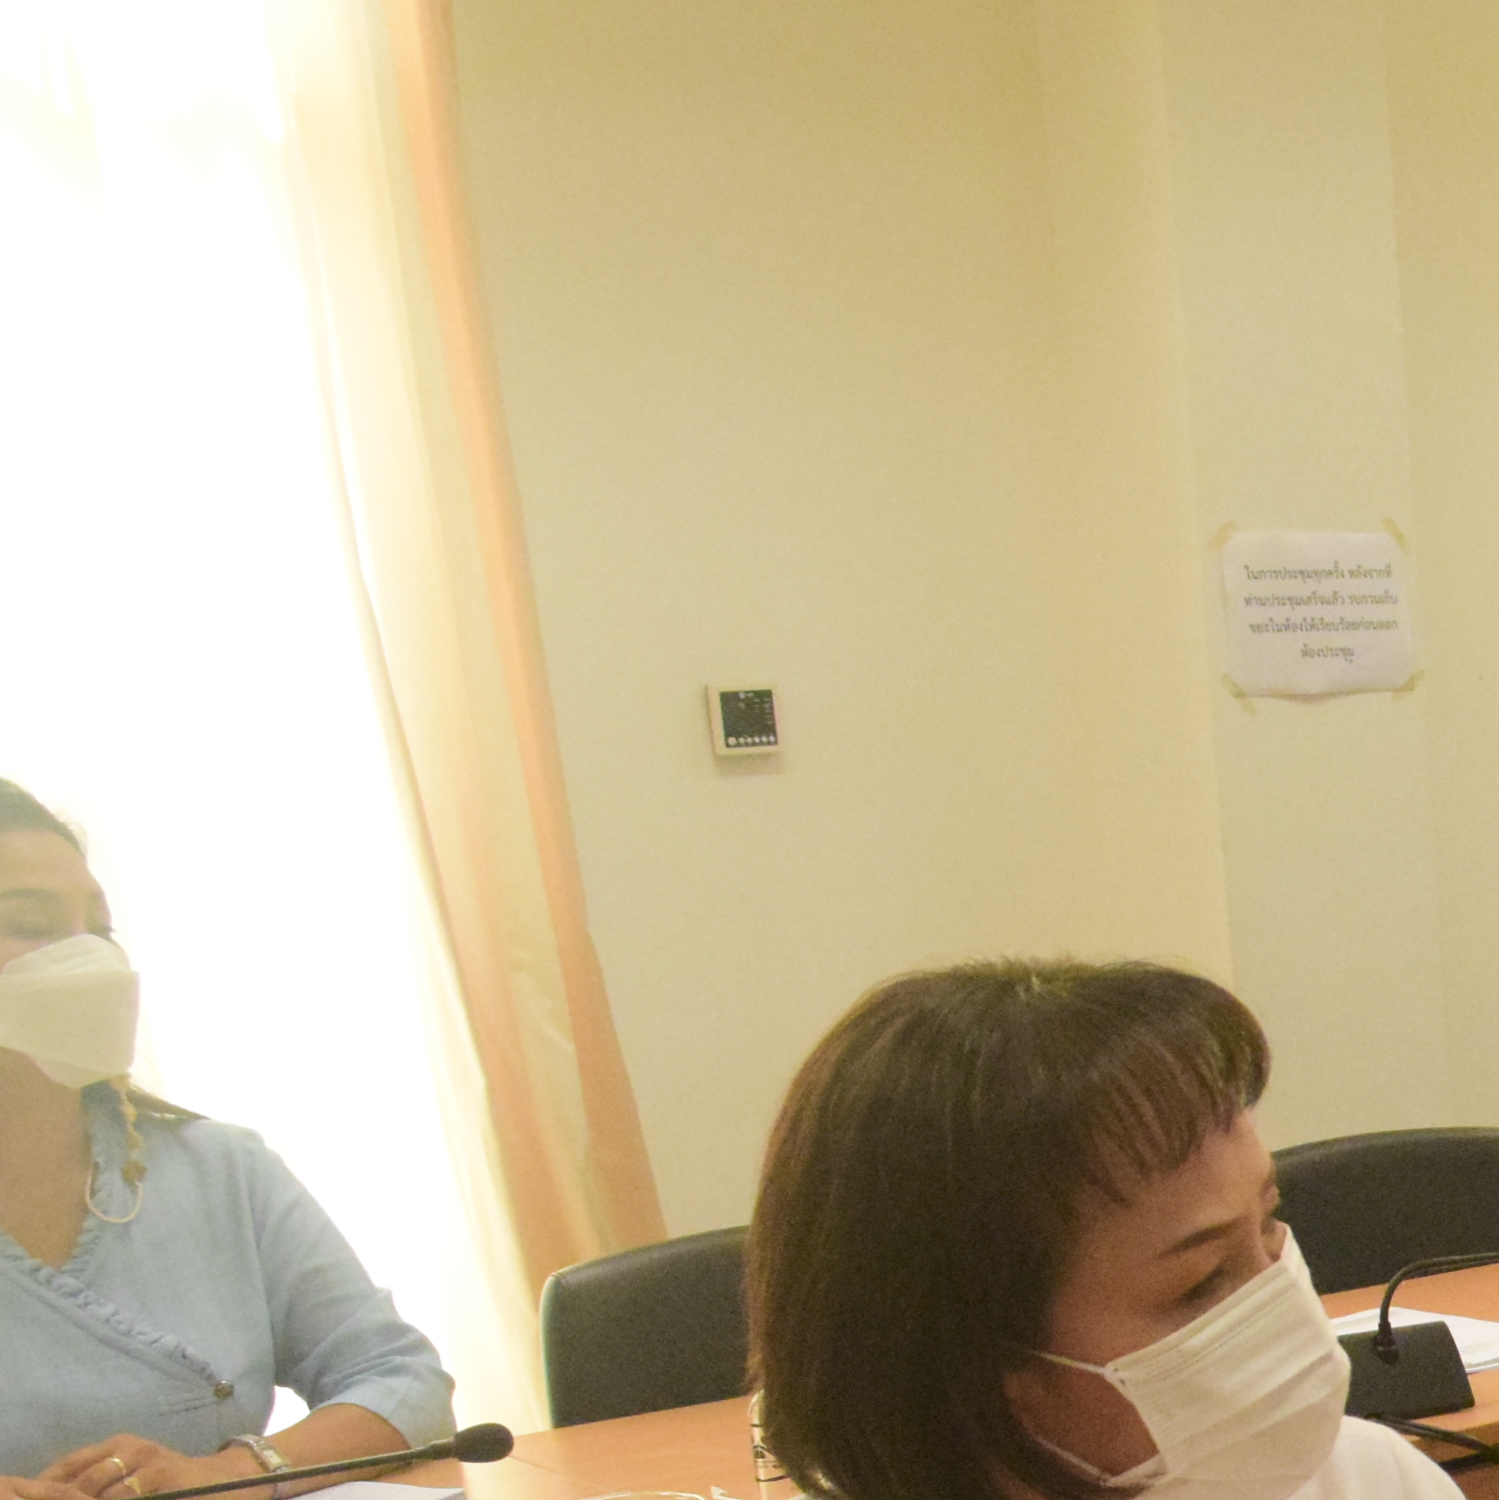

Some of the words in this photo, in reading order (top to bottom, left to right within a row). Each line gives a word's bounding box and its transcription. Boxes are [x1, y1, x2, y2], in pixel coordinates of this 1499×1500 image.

[1245, 562, 1345, 583] ในการประชุมทุกครั้ง
[1300, 644, 1355, 664] ห้องประชุม
